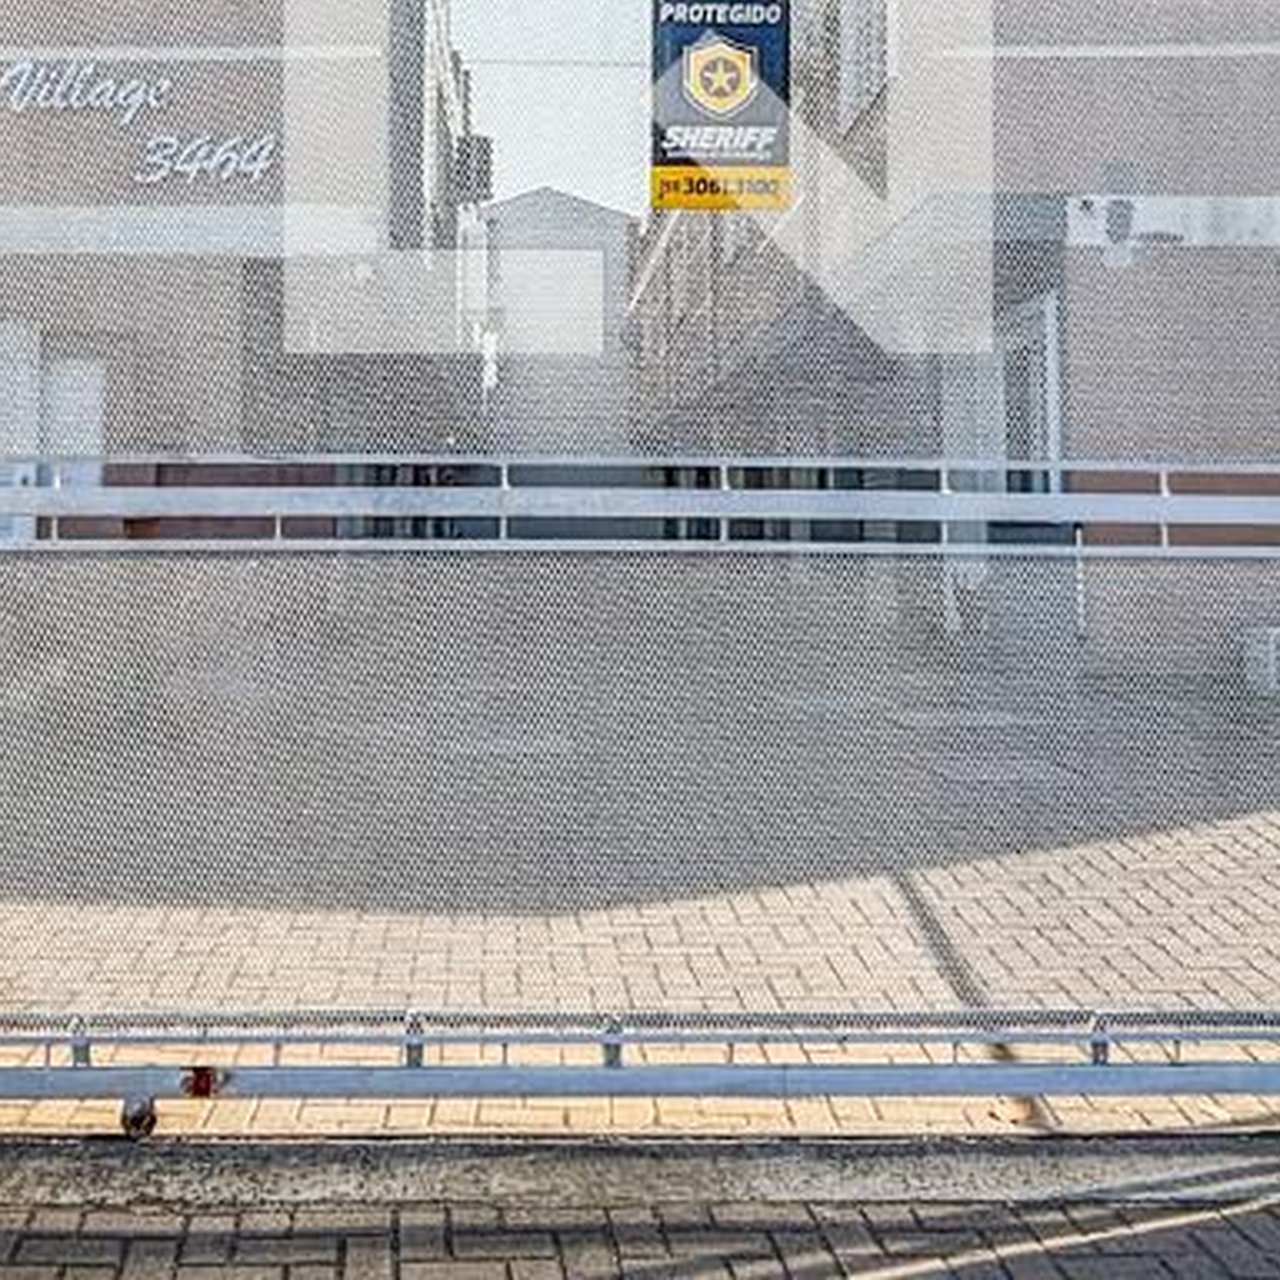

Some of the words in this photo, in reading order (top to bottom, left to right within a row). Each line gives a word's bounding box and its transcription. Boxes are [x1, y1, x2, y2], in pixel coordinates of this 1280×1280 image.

[660, 2, 782, 23] PROTEGIDO
[1, 58, 172, 126] Village
[662, 125, 778, 149] SHERIFF
[134, 132, 276, 185] 3464
